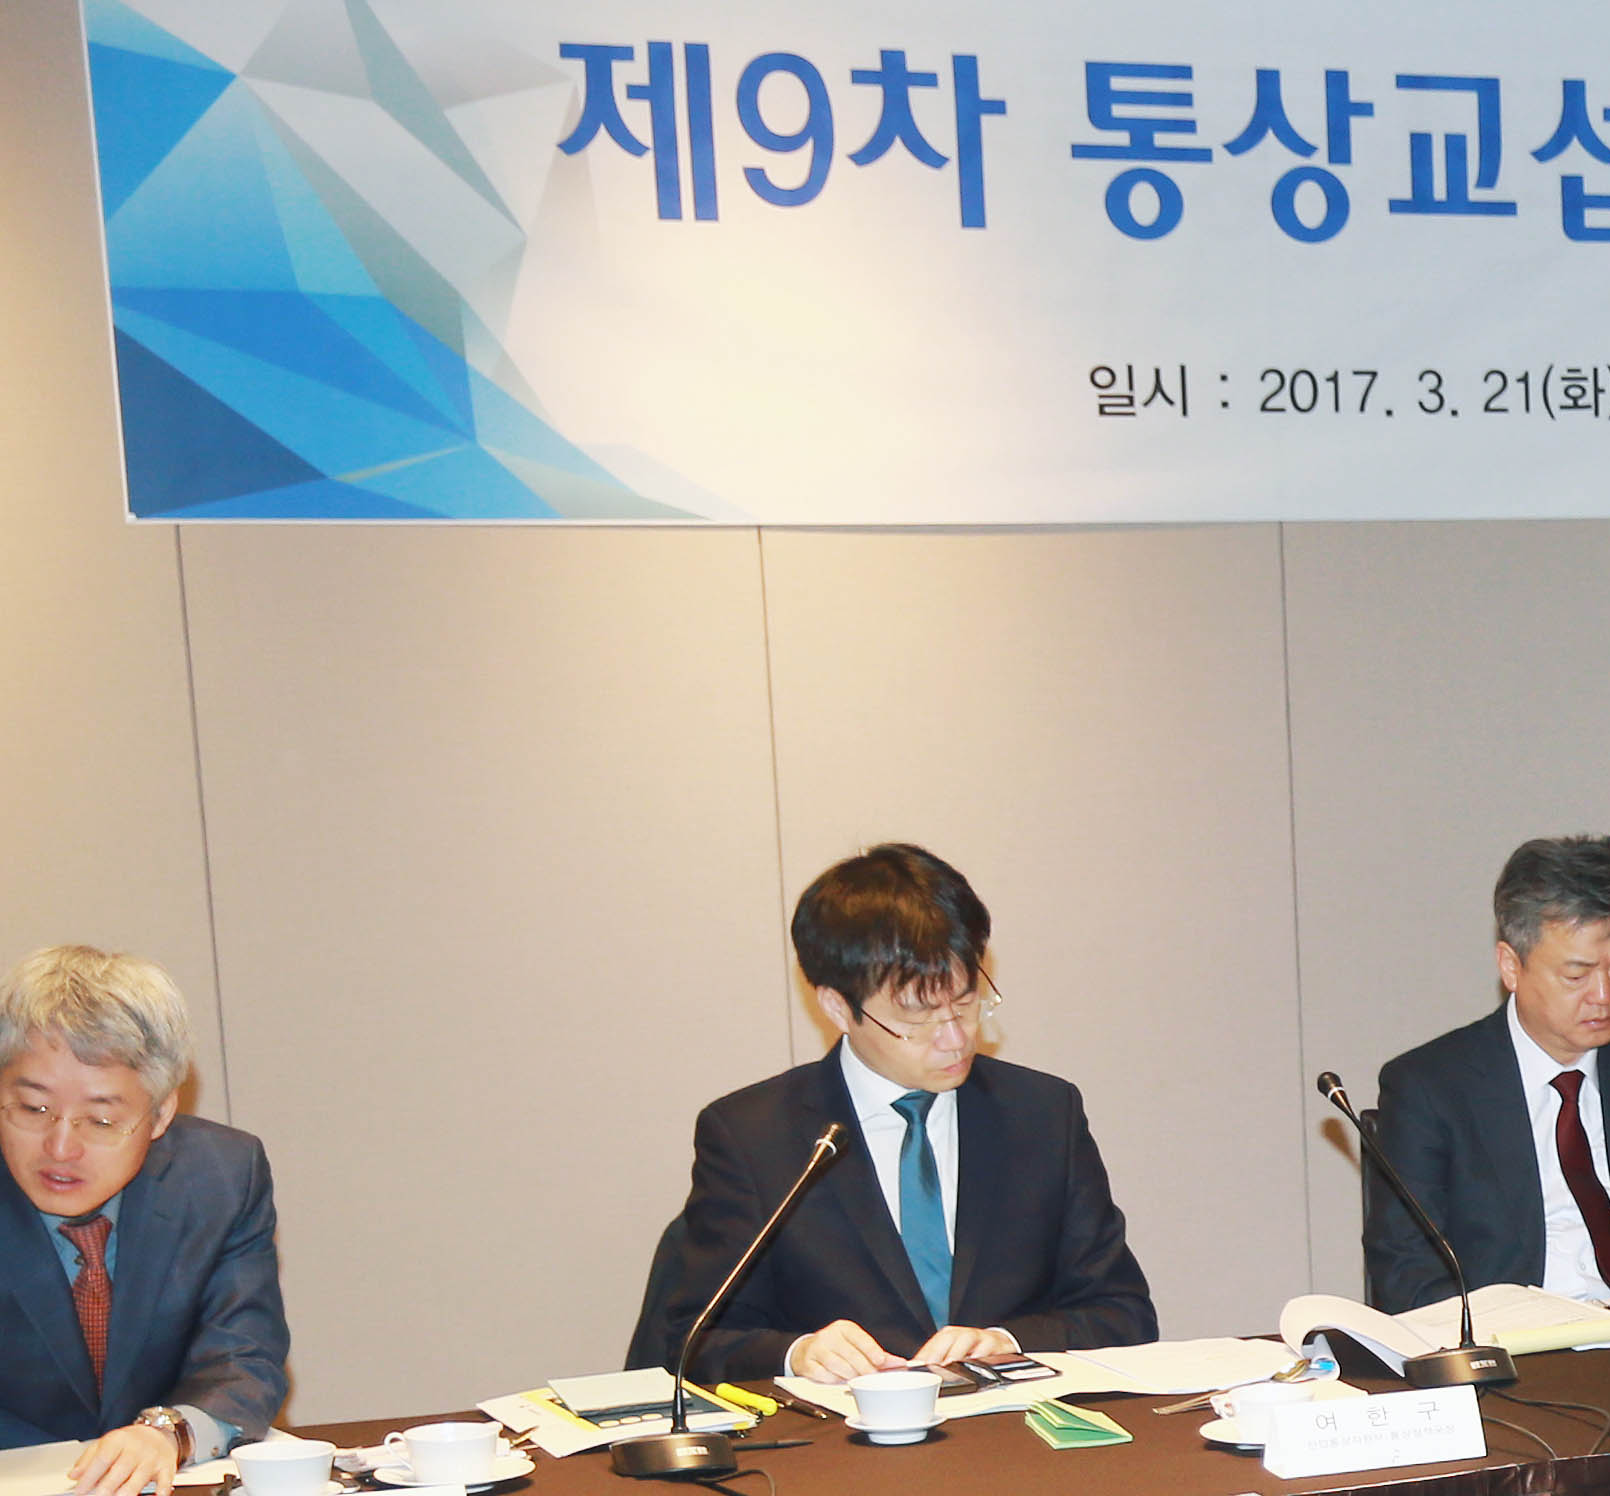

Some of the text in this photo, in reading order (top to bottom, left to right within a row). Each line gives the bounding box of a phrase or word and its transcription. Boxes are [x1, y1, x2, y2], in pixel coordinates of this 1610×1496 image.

[559, 41, 1007, 229] 제9차
[1089, 364, 1189, 417] 일시
[1259, 368, 1394, 417] 2017.
[1417, 369, 1459, 417] 3.
